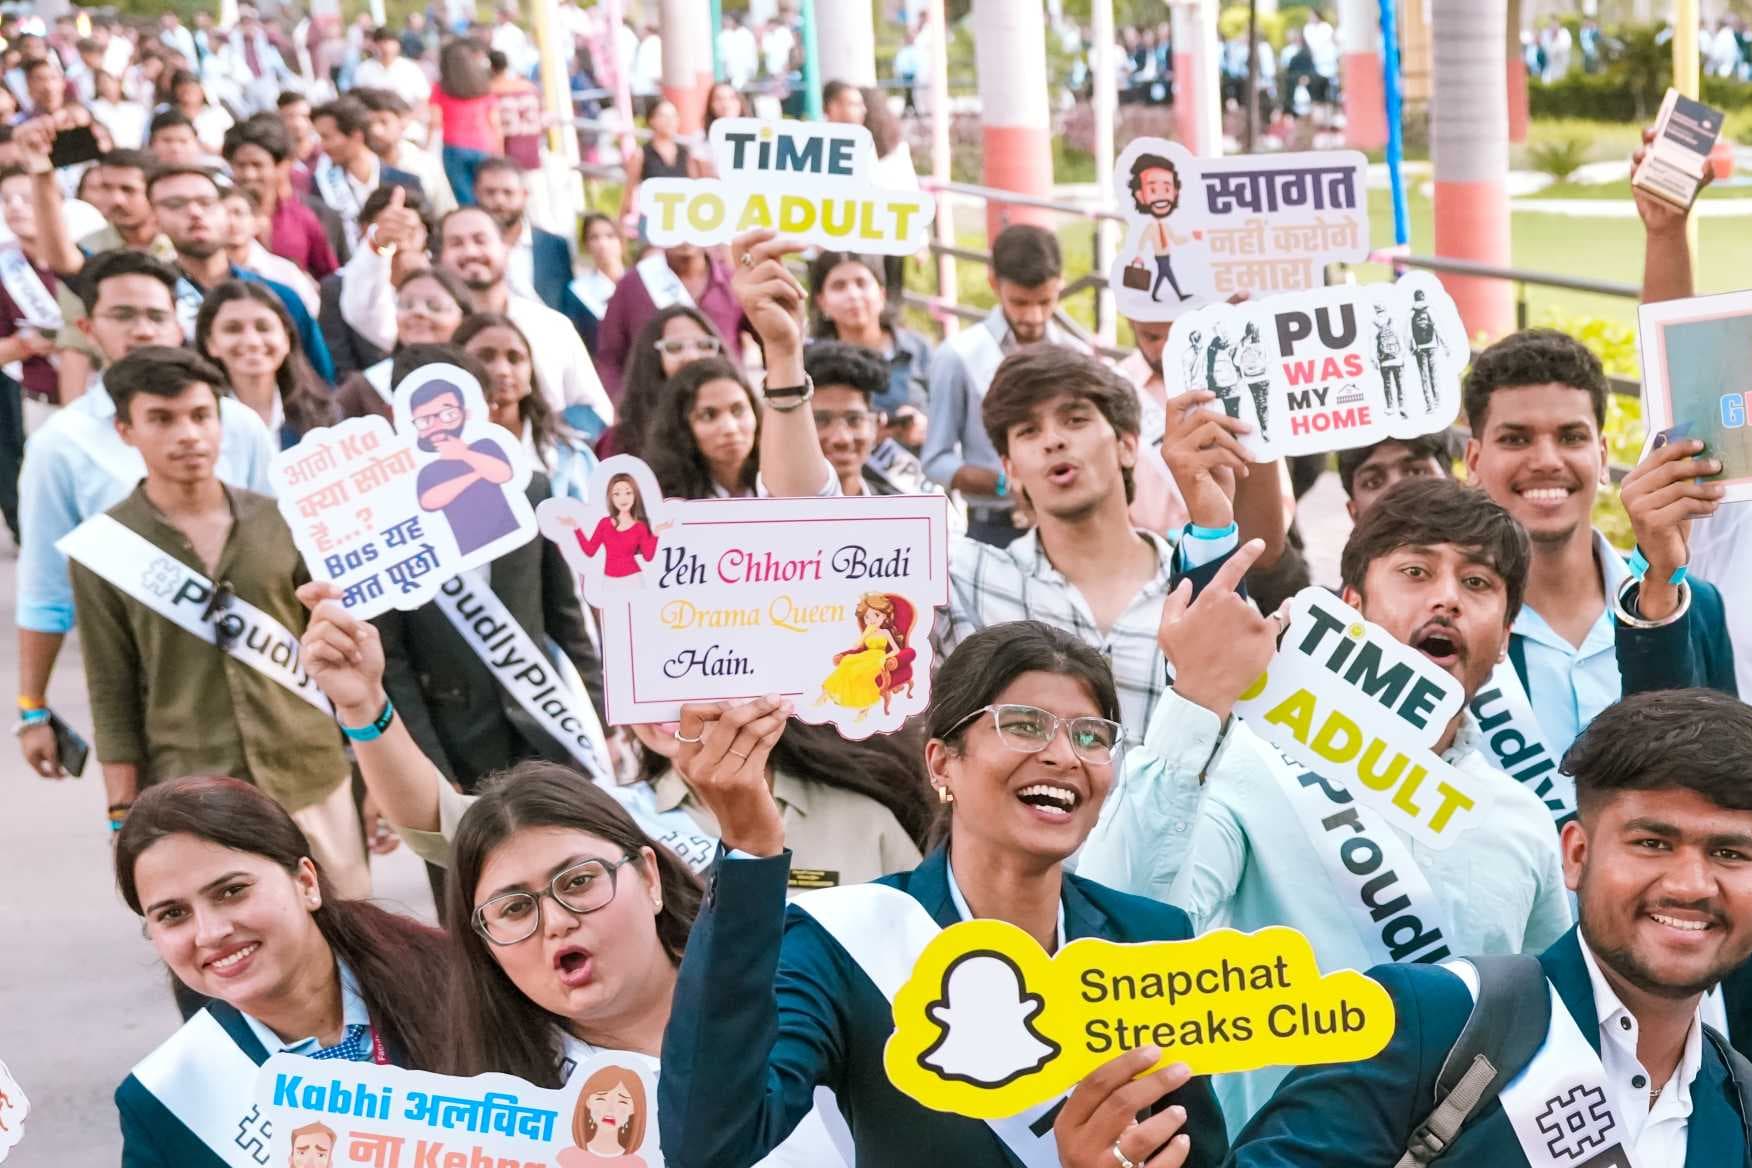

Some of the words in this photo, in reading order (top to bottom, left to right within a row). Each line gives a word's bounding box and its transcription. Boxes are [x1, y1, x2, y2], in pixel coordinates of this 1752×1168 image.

[1201, 166, 1356, 214] स्वागत
[654, 193, 726, 232] TO
[736, 194, 920, 241] ADULT
[1274, 303, 1357, 357] PU
[1282, 354, 1364, 386] WAS
[1287, 386, 1329, 411] MY
[1291, 405, 1372, 436] HOME
[340, 431, 380, 461] Ka
[324, 542, 379, 579] Bas
[380, 515, 424, 548] यह
[658, 546, 707, 589] Yeh
[717, 548, 823, 584] Chhori
[831, 544, 912, 580] Badi
[341, 573, 384, 608] मत
[385, 543, 440, 593] पूछो
[659, 599, 761, 631] Drama
[768, 594, 847, 634] Queen
[663, 644, 756, 680] Hain.
[1264, 688, 1476, 834] ADULT
[1080, 955, 1291, 1006] Snapchat
[1085, 1010, 1253, 1053] Streaks
[1268, 1000, 1366, 1038] Club
[273, 1073, 393, 1120] Kabhi
[404, 1091, 558, 1142] अलविदा
